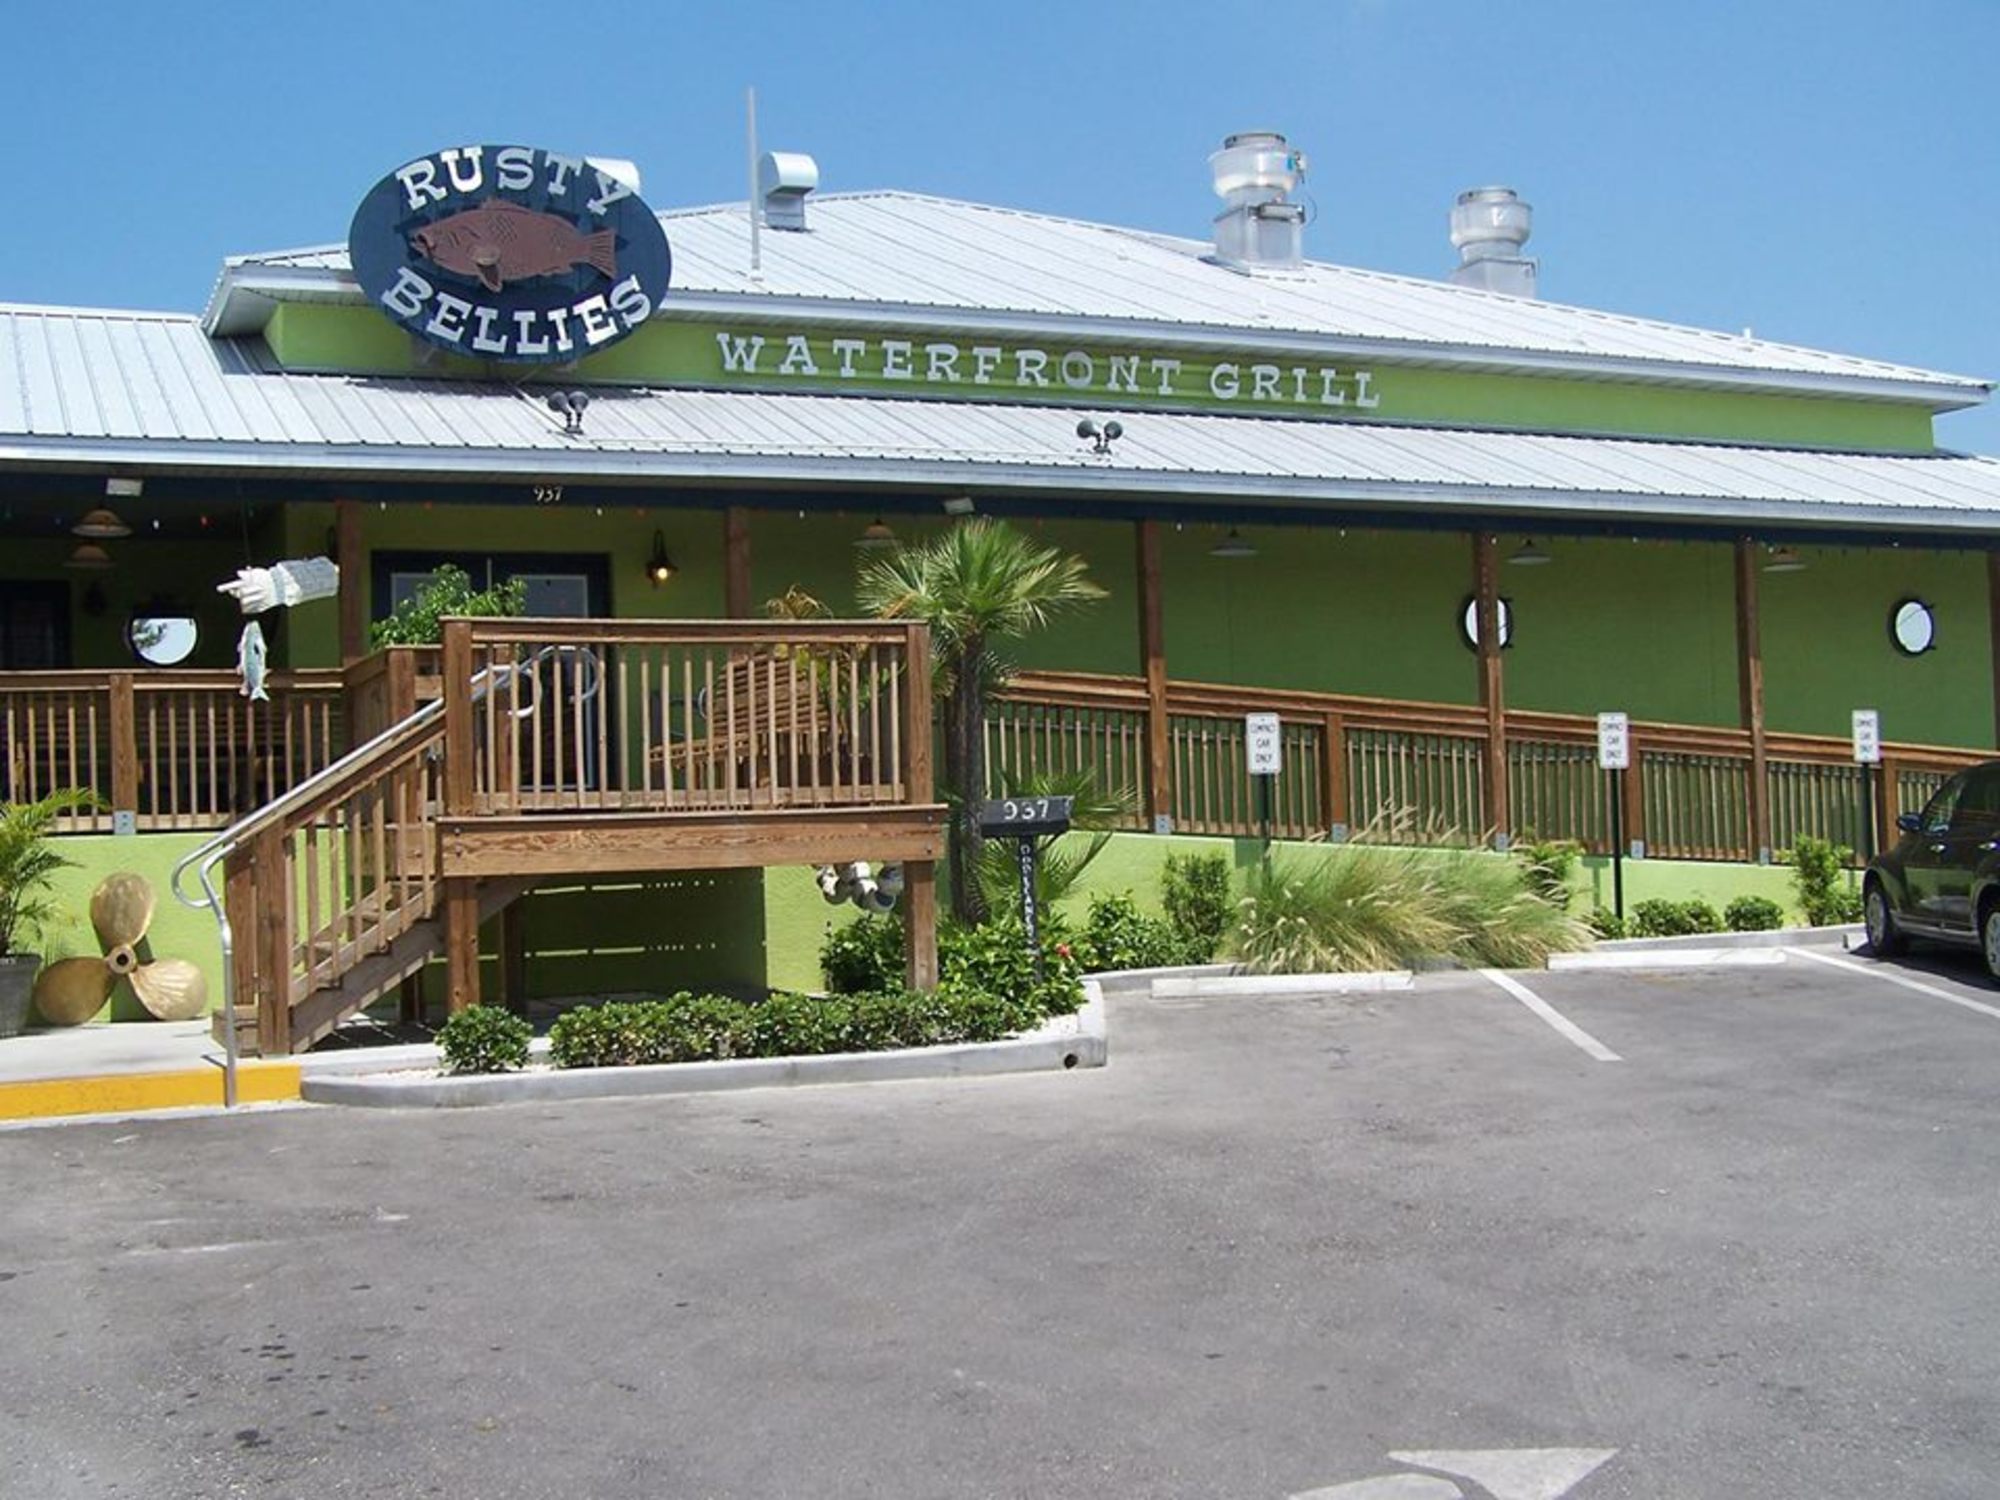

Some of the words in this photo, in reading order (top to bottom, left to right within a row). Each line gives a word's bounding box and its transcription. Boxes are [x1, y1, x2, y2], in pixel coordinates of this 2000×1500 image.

[395, 146, 633, 216] RUSTY
[381, 267, 652, 355] BELLIES
[716, 332, 1181, 395] WATERFRONT
[1210, 363, 1379, 407] GRILL
[533, 486, 564, 503] 937
[1003, 799, 1049, 821] 937
